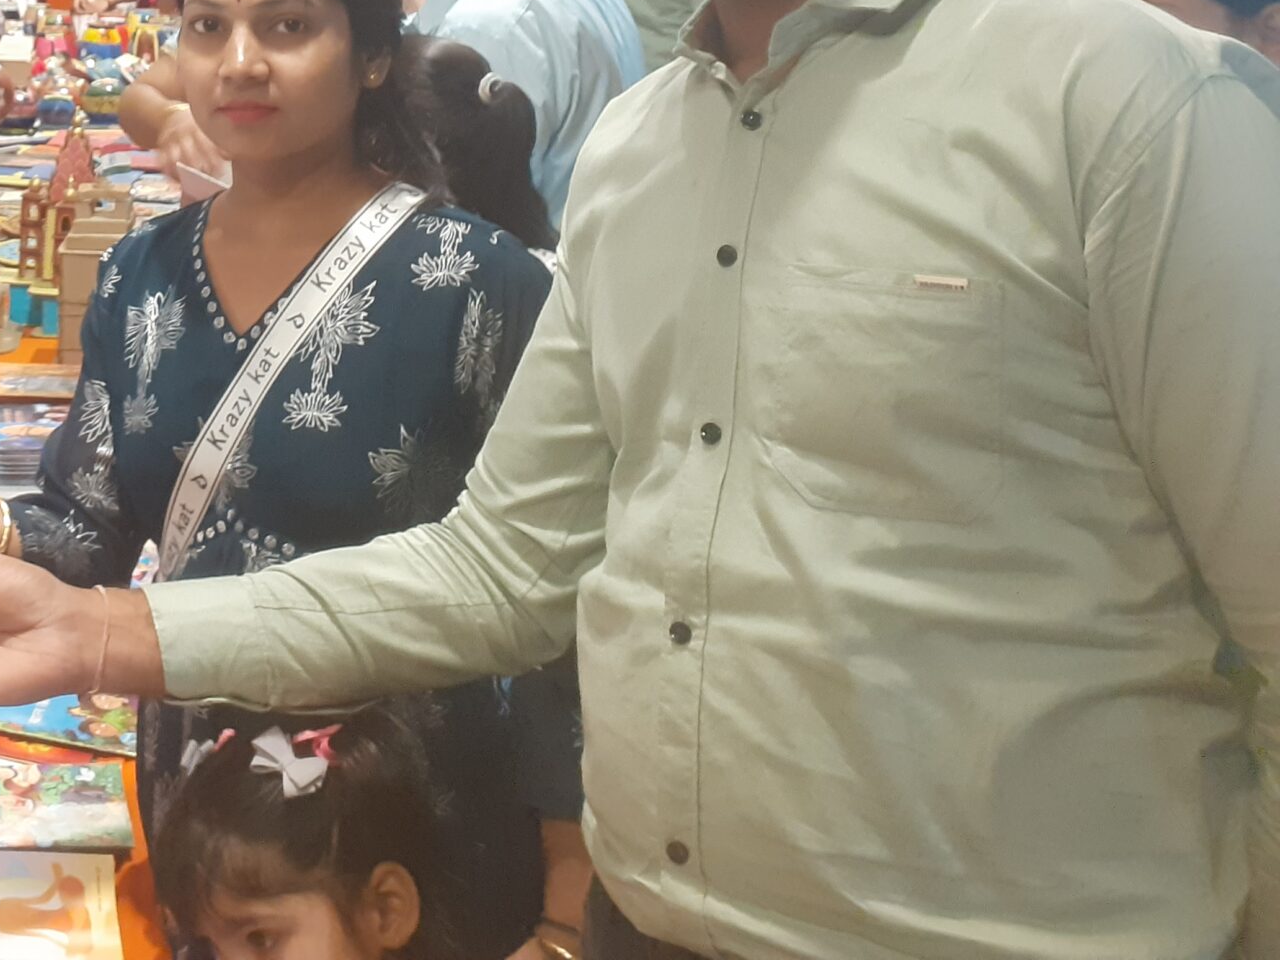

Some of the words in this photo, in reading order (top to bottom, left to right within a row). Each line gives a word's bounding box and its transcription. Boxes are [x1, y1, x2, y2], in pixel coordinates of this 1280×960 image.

[311, 234, 368, 293] Krazy
[360, 202, 398, 238] kat
[207, 389, 253, 451] Krazy
[247, 346, 281, 384] kat
[177, 503, 195, 536] kat
